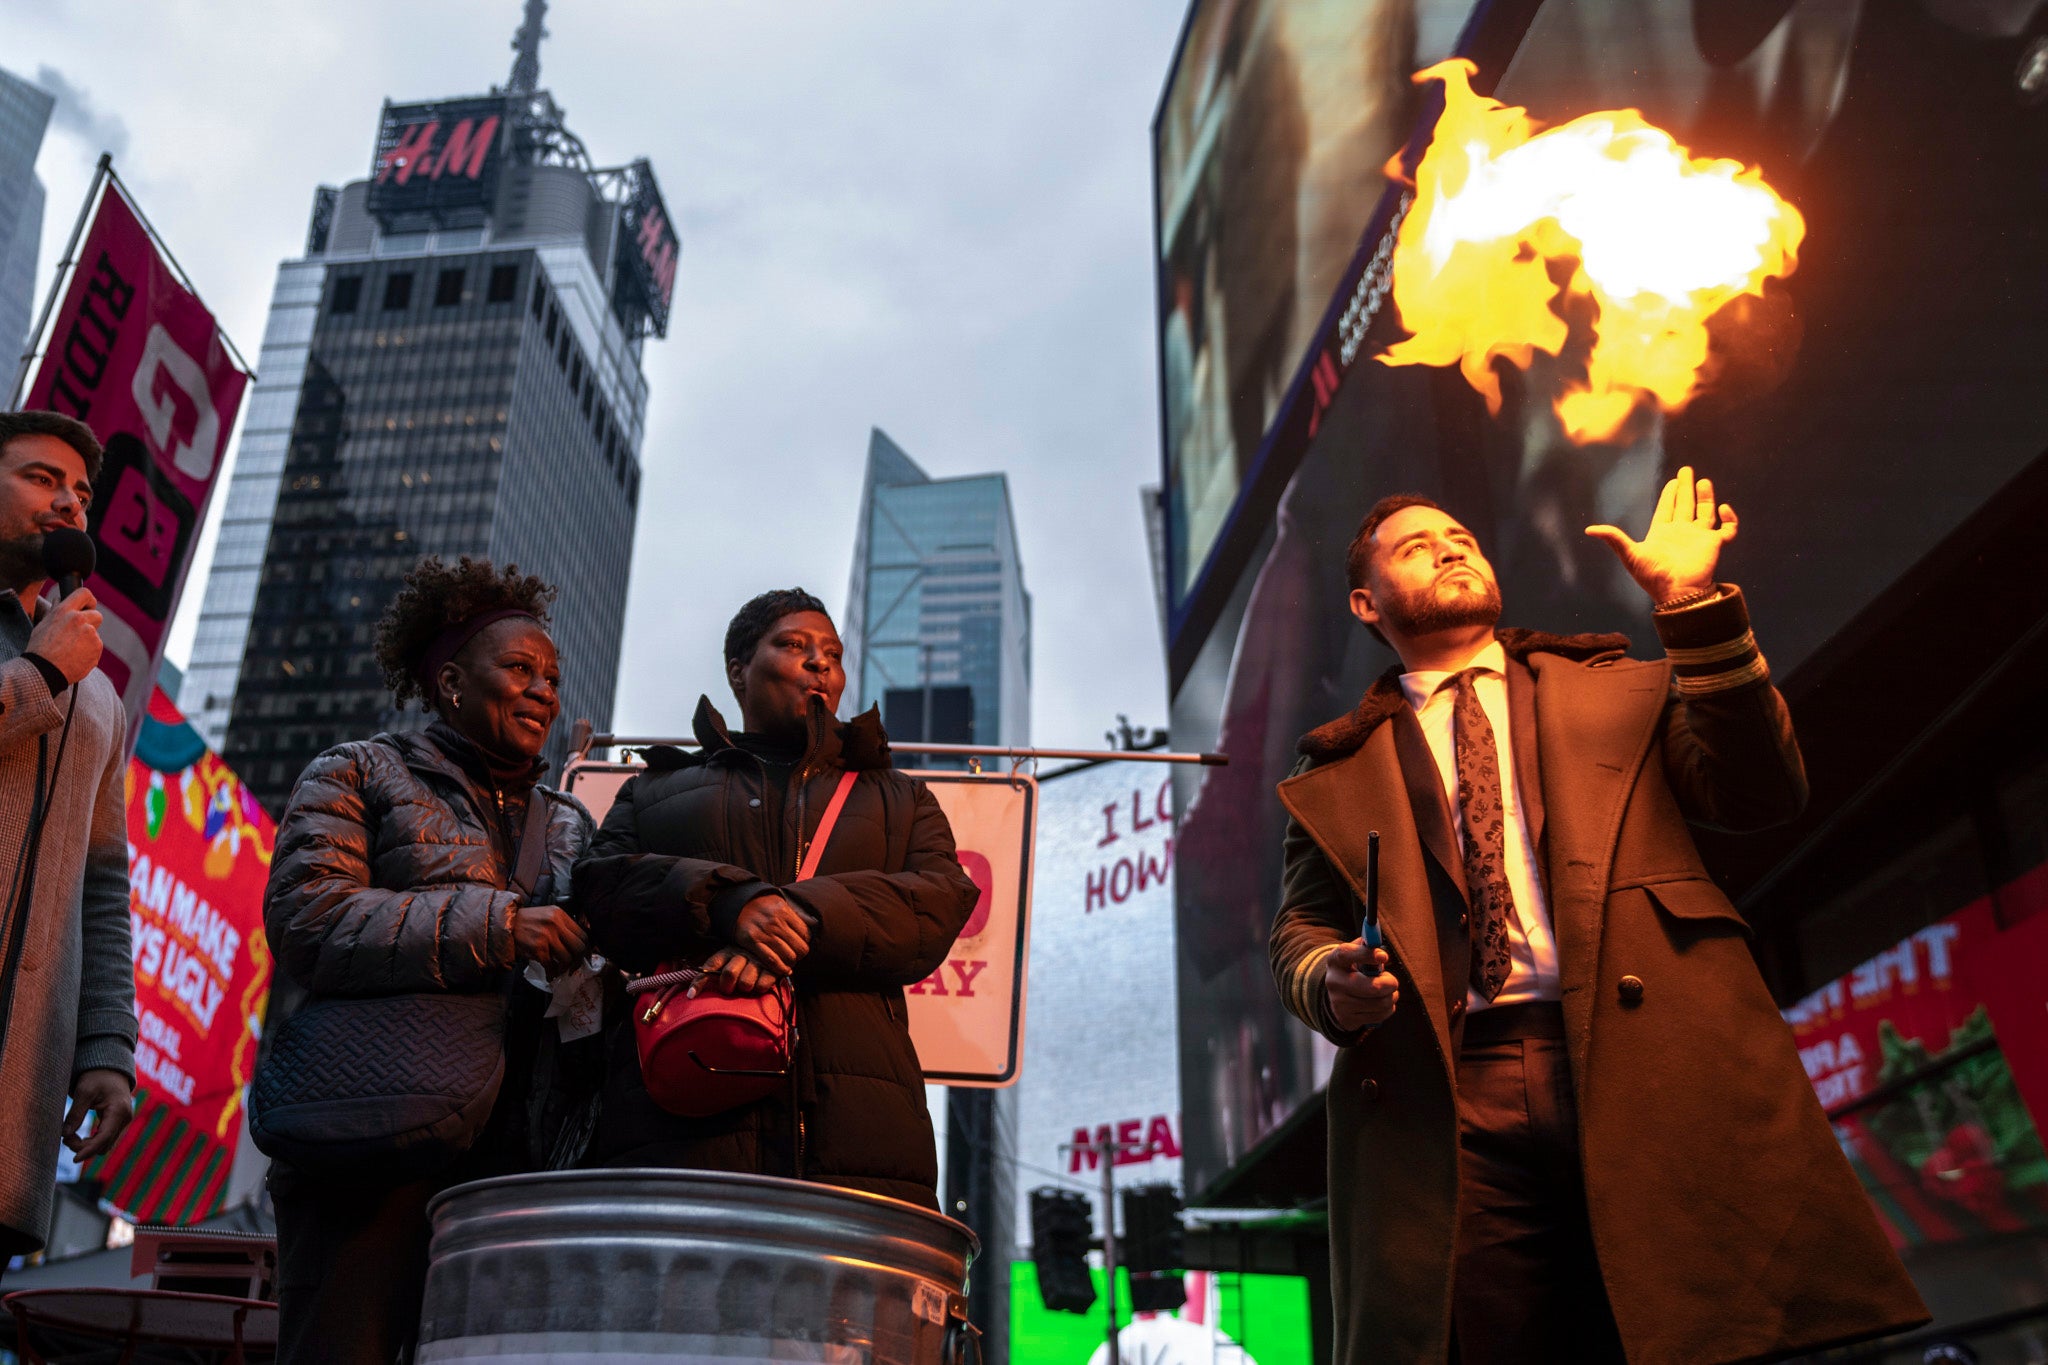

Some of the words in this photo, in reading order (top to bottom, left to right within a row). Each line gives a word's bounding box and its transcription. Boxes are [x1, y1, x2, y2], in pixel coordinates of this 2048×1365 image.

[46, 250, 136, 422] RIDD
[1097, 802, 1120, 849] I
[128, 842, 175, 918] AN
[167, 879, 241, 983] MAKE
[1084, 838, 1174, 914] HOW
[131, 911, 166, 978] YS
[161, 937, 225, 1031] UGLY
[907, 959, 988, 998] AY
[1068, 1112, 1183, 1175] MEA
